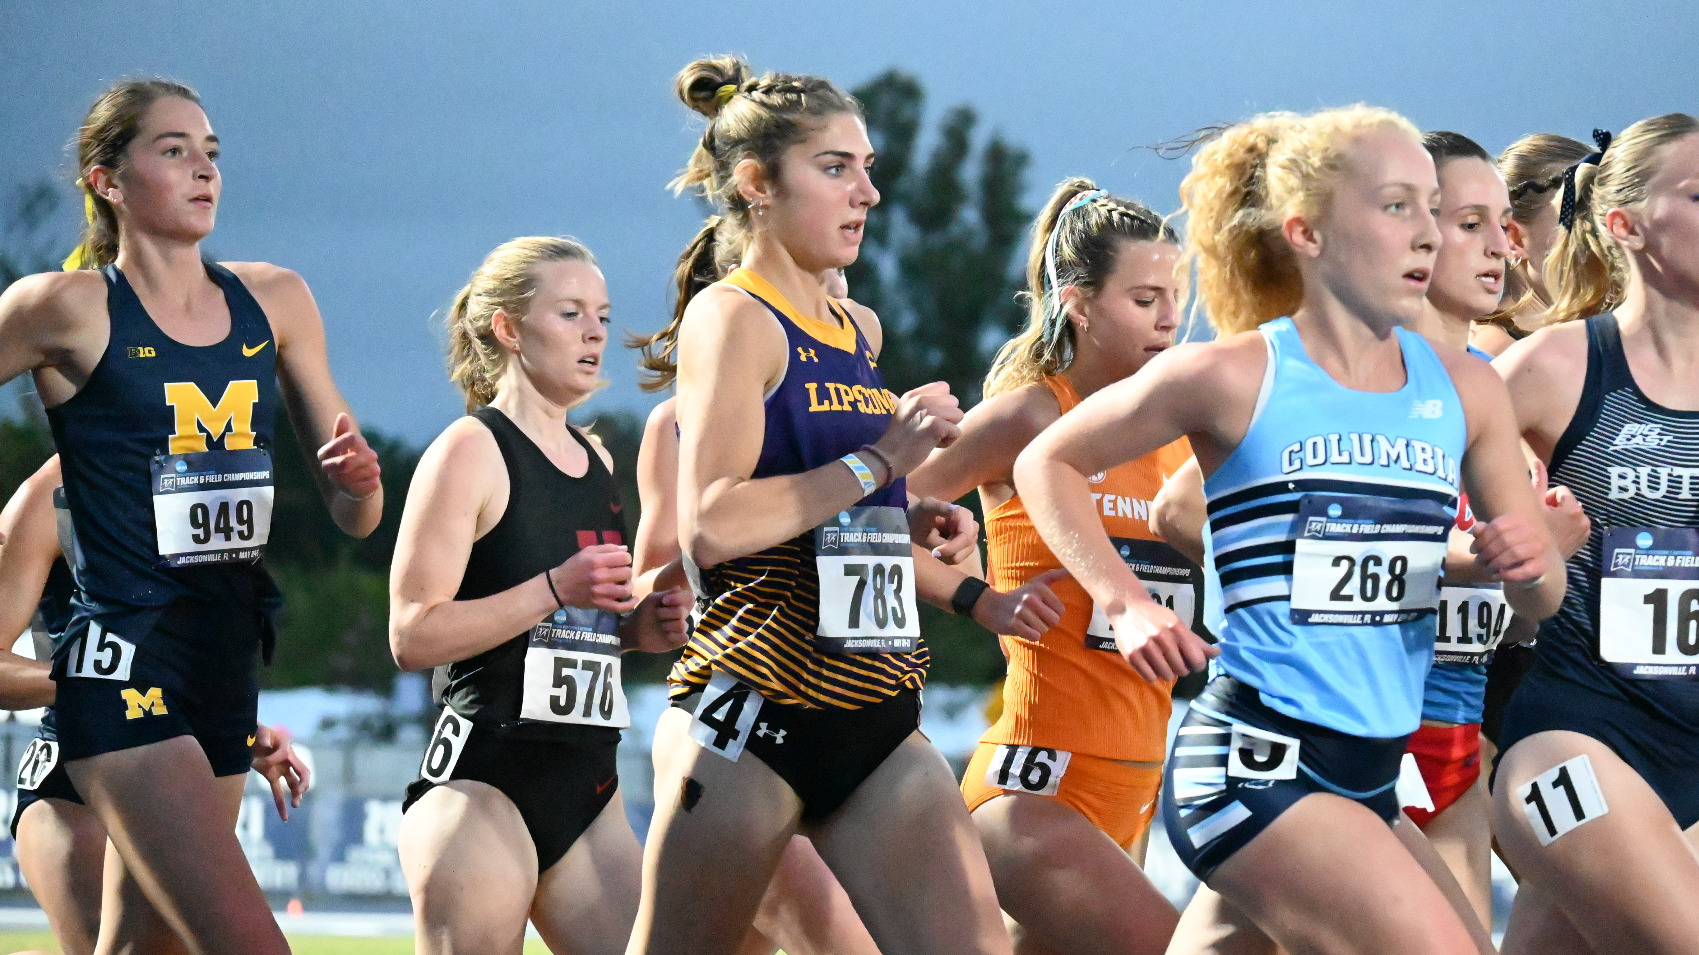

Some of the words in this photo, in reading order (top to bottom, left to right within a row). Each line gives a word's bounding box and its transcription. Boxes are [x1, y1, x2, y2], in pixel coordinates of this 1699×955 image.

[164, 380, 259, 455] M
[1612, 434, 1674, 446] EAST
[1619, 423, 1662, 435] BIG
[176, 475, 199, 486] TRACK
[205, 473, 223, 483] FIELD
[223, 470, 270, 482] CHAMPIONSHIPS
[1280, 432, 1458, 487] COLUMBIA
[189, 499, 254, 545] 949
[840, 532, 863, 543] TRACK
[867, 532, 882, 543] FIELD
[1325, 522, 1352, 533] TRACK
[1360, 523, 1381, 534] FIELD
[1381, 523, 1445, 536] CHAMPIONSHIPS
[1329, 555, 1409, 603] 268
[1634, 554, 1667, 566] TRACK
[843, 562, 907, 630] 783
[551, 628, 576, 640] TRACK
[581, 631, 596, 642] FIELD
[1436, 599, 1507, 646] 1194
[75, 620, 122, 676] 15
[121, 687, 168, 720] M
[549, 656, 615, 721] 576
[698, 680, 751, 751] 4
[426, 714, 461, 779] 6
[997, 744, 1057, 791] 16
[1525, 765, 1586, 838] 11
